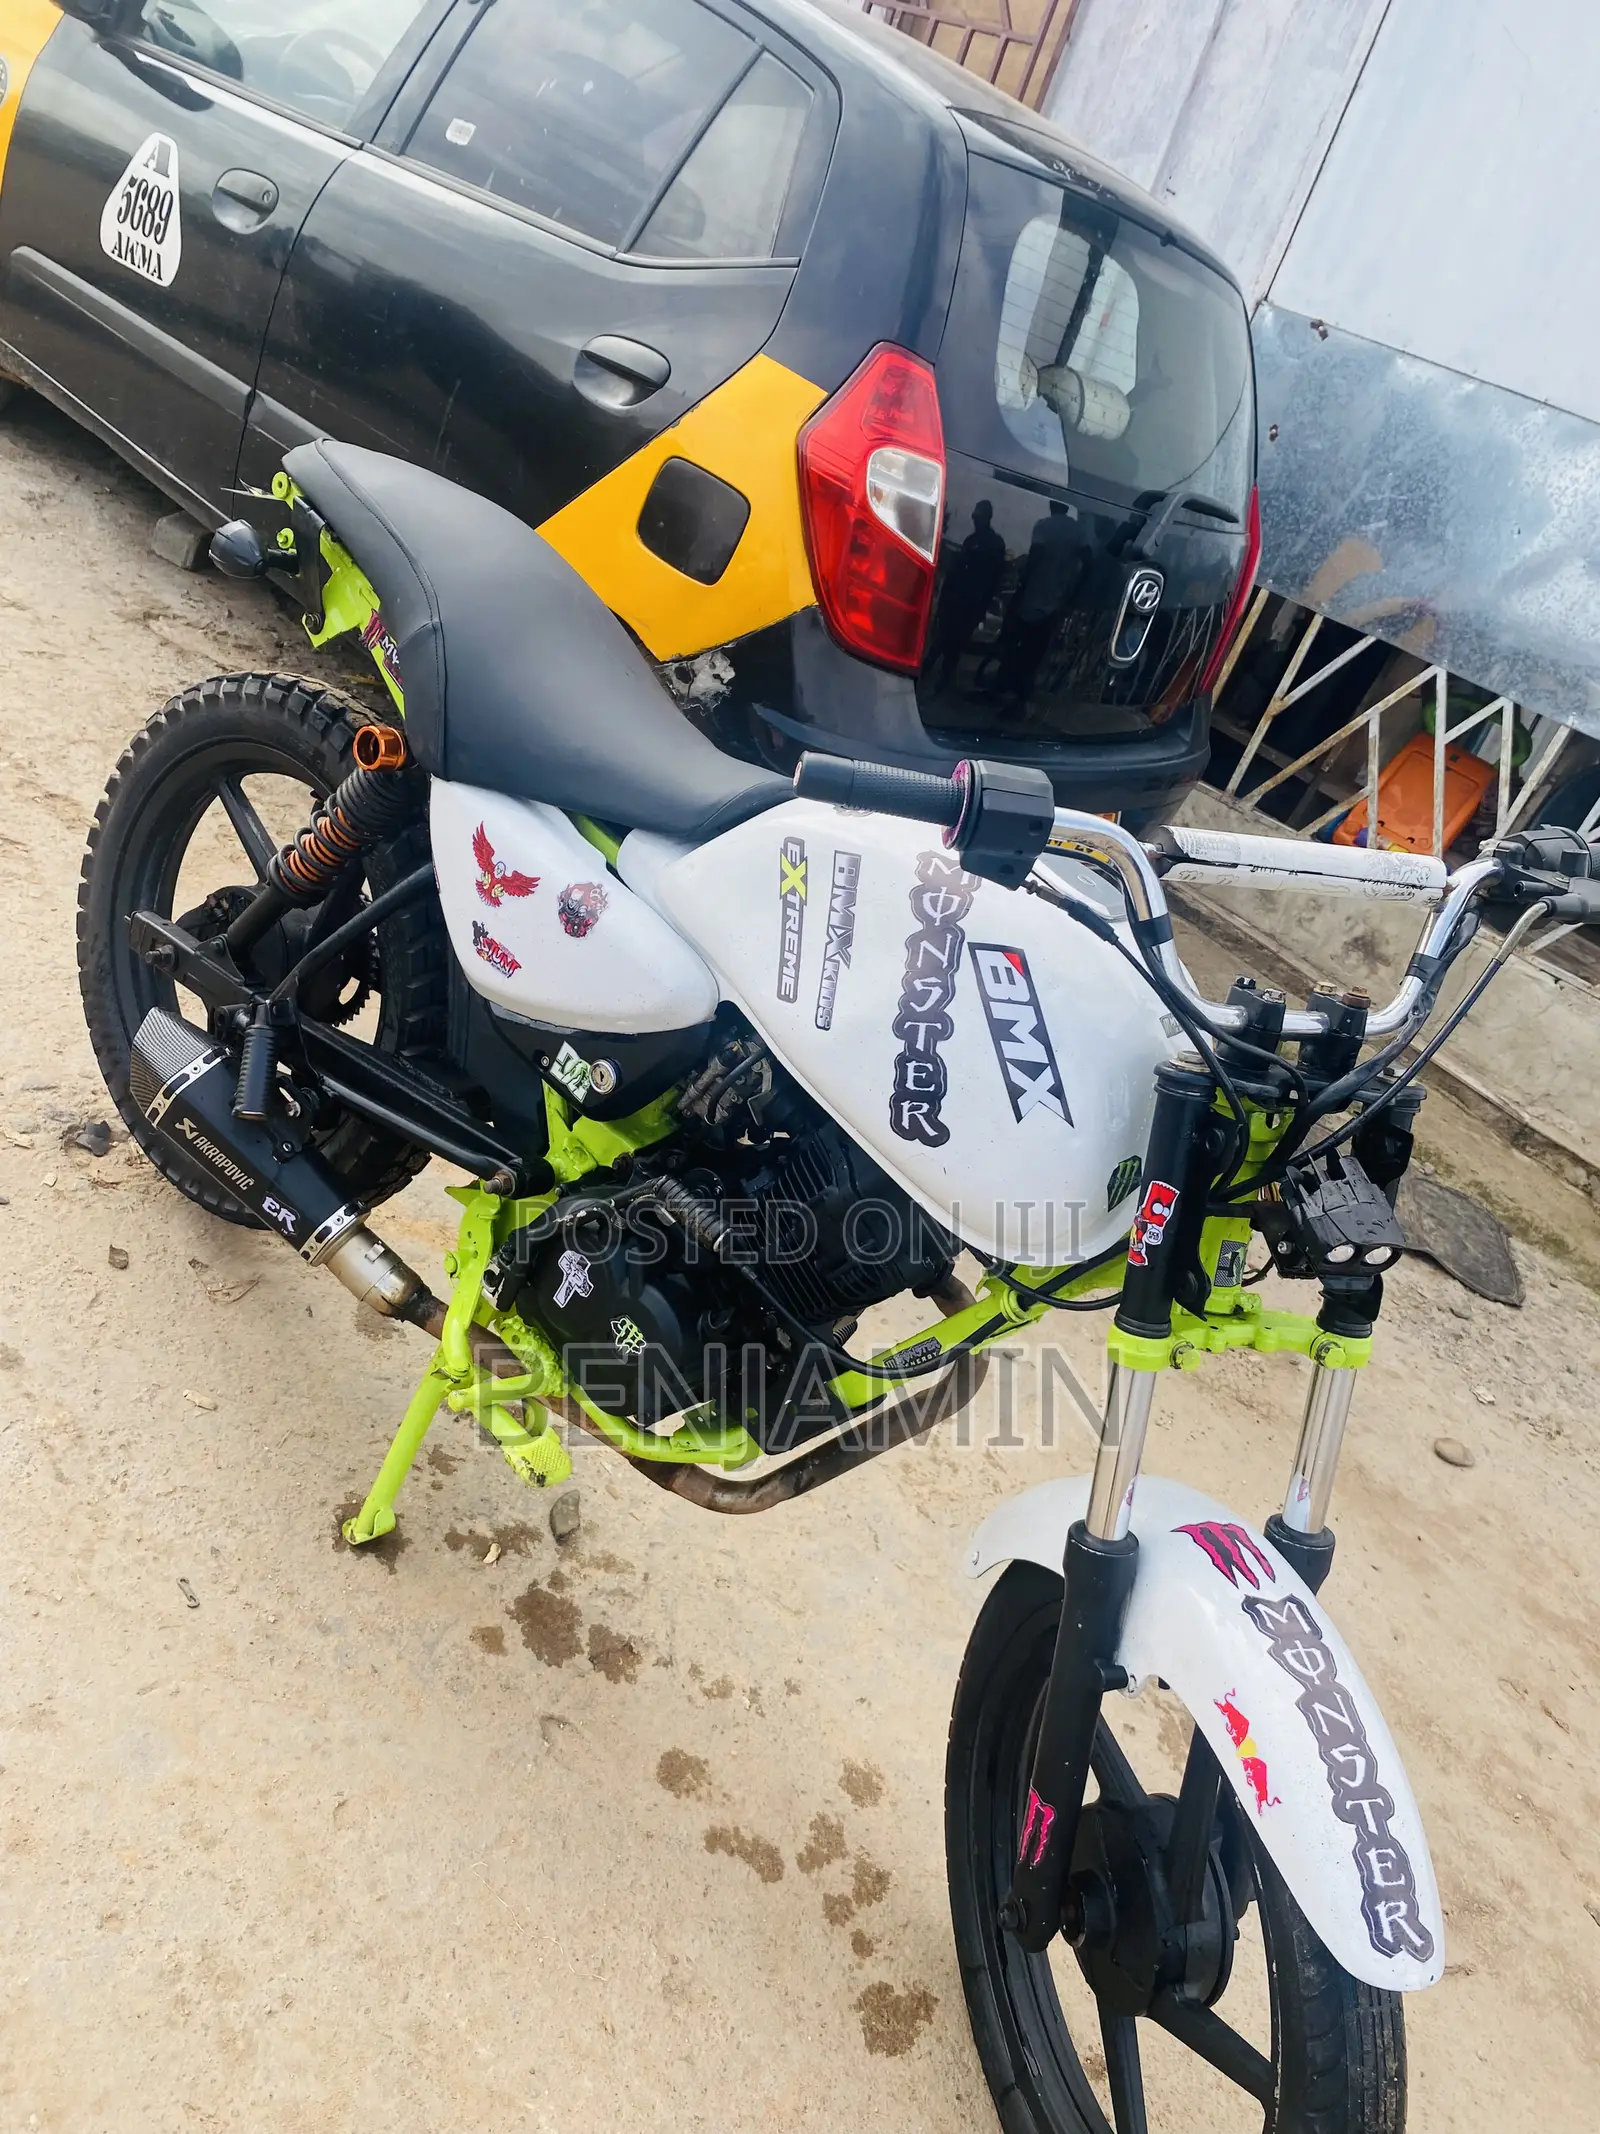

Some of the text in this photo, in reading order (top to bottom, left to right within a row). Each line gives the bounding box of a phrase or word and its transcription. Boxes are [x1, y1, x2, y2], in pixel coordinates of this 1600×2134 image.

[116, 174, 174, 245] 5689
[780, 841, 807, 999] EXTREME
[816, 851, 861, 1030] BMX KIDS
[901, 856, 971, 1137] MONSTER
[974, 949, 1066, 1122] BMX
[193, 1136, 255, 1190] AKRAPOVIČ
[261, 1196, 297, 1233] ER
[1255, 1600, 1425, 1949] MONSTER
